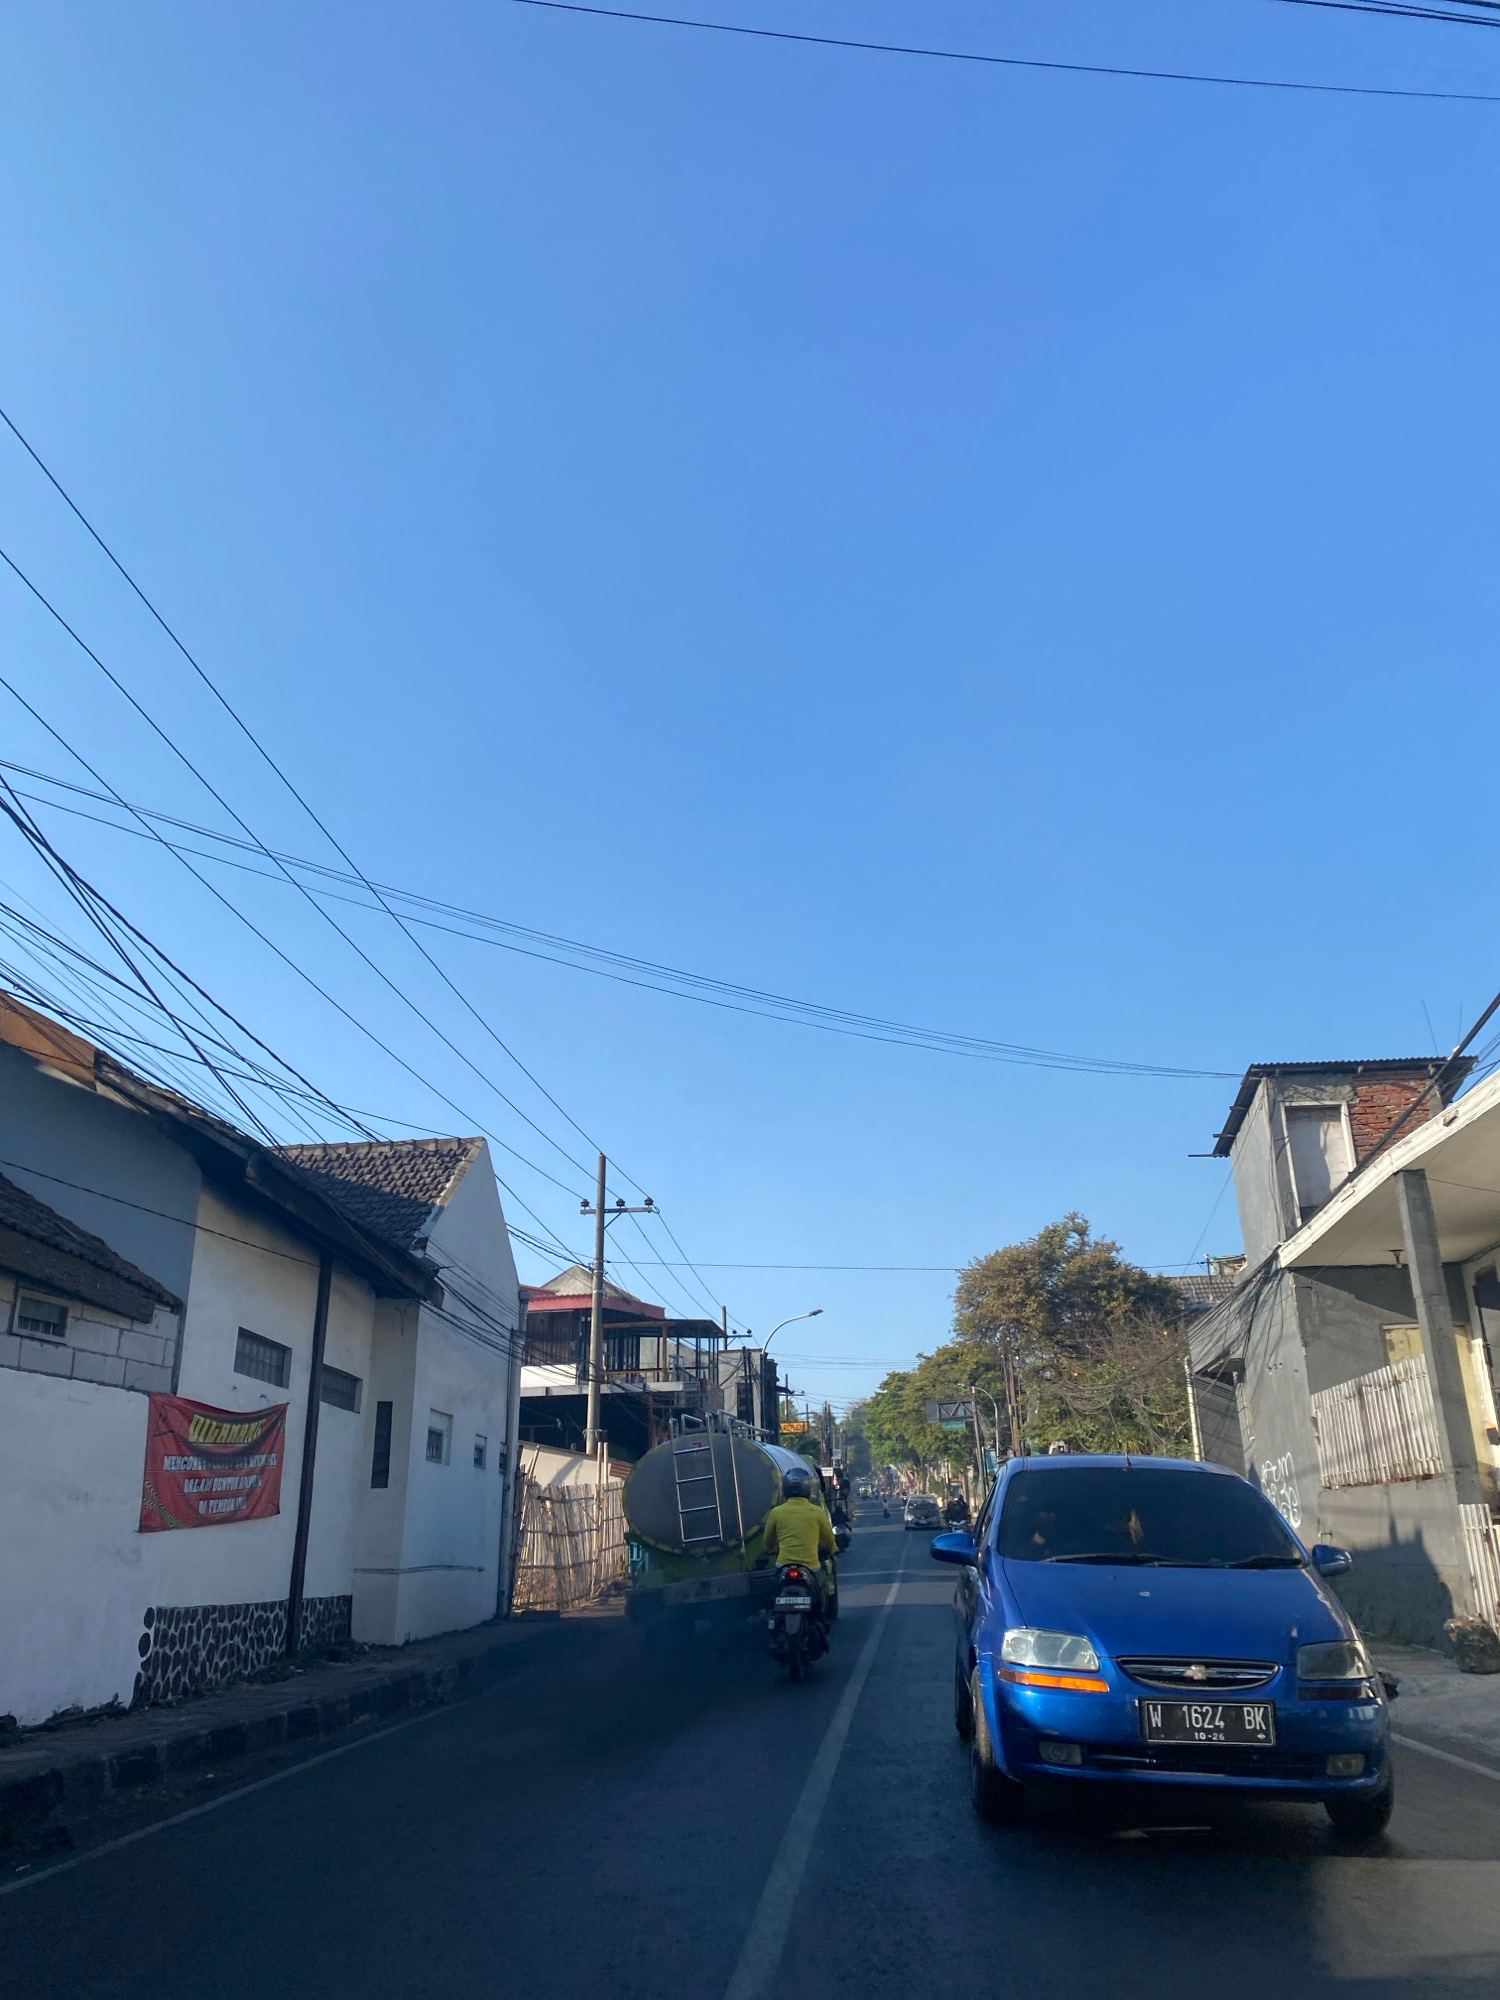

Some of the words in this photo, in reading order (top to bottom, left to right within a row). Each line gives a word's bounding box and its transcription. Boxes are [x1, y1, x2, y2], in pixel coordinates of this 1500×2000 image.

[188, 1414, 267, 1443] DILARANG
[1149, 1704, 1162, 1728] W
[1182, 1704, 1226, 1729] 1624
[1243, 1706, 1267, 1730] BK
